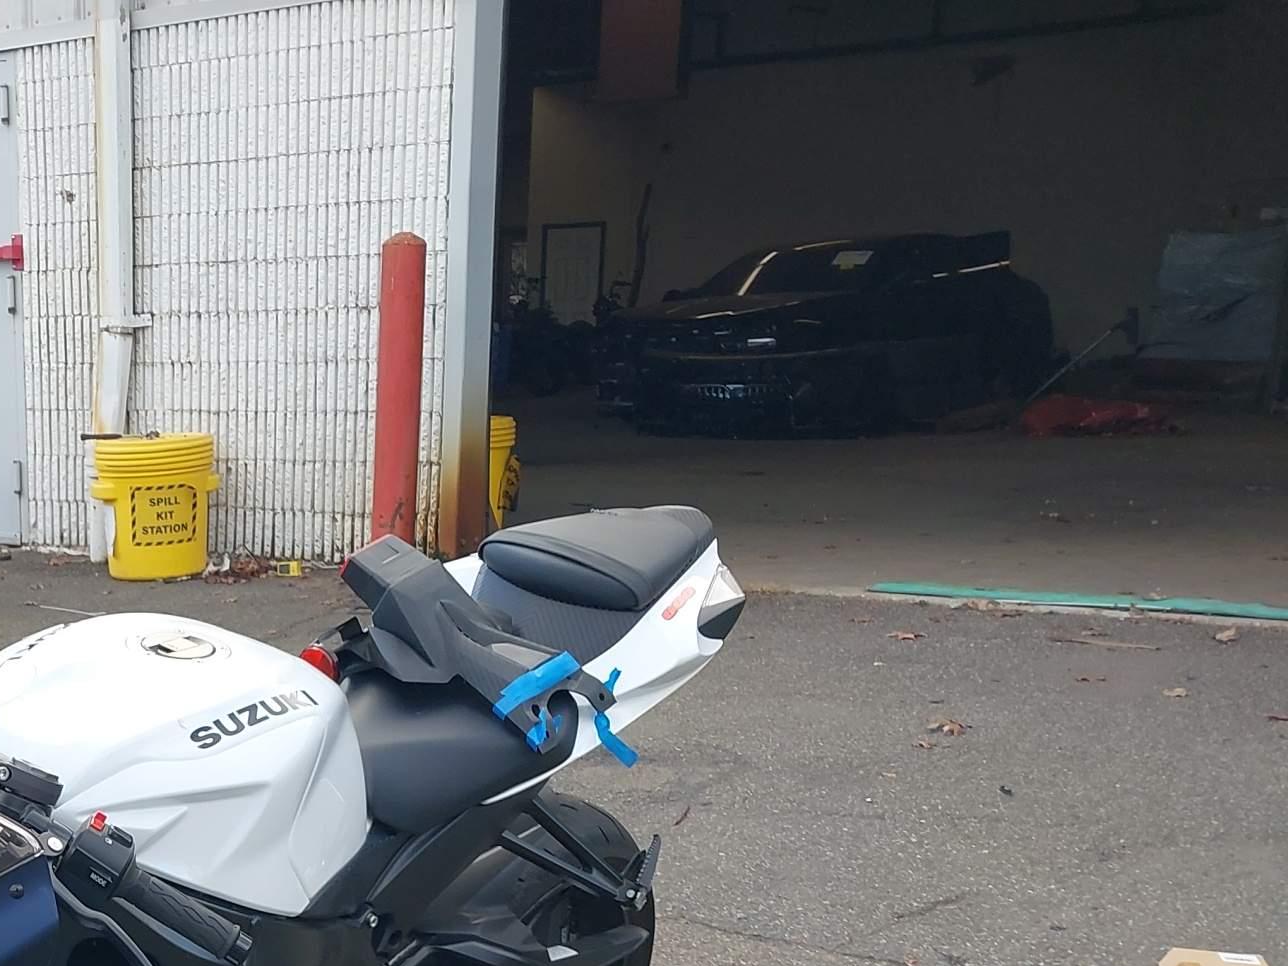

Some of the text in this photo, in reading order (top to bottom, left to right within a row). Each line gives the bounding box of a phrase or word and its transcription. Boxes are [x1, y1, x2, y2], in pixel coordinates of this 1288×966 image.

[149, 496, 180, 507] SPILL
[156, 510, 175, 520] KIT
[142, 522, 188, 535] STATION
[190, 690, 319, 749] SUZUKI
